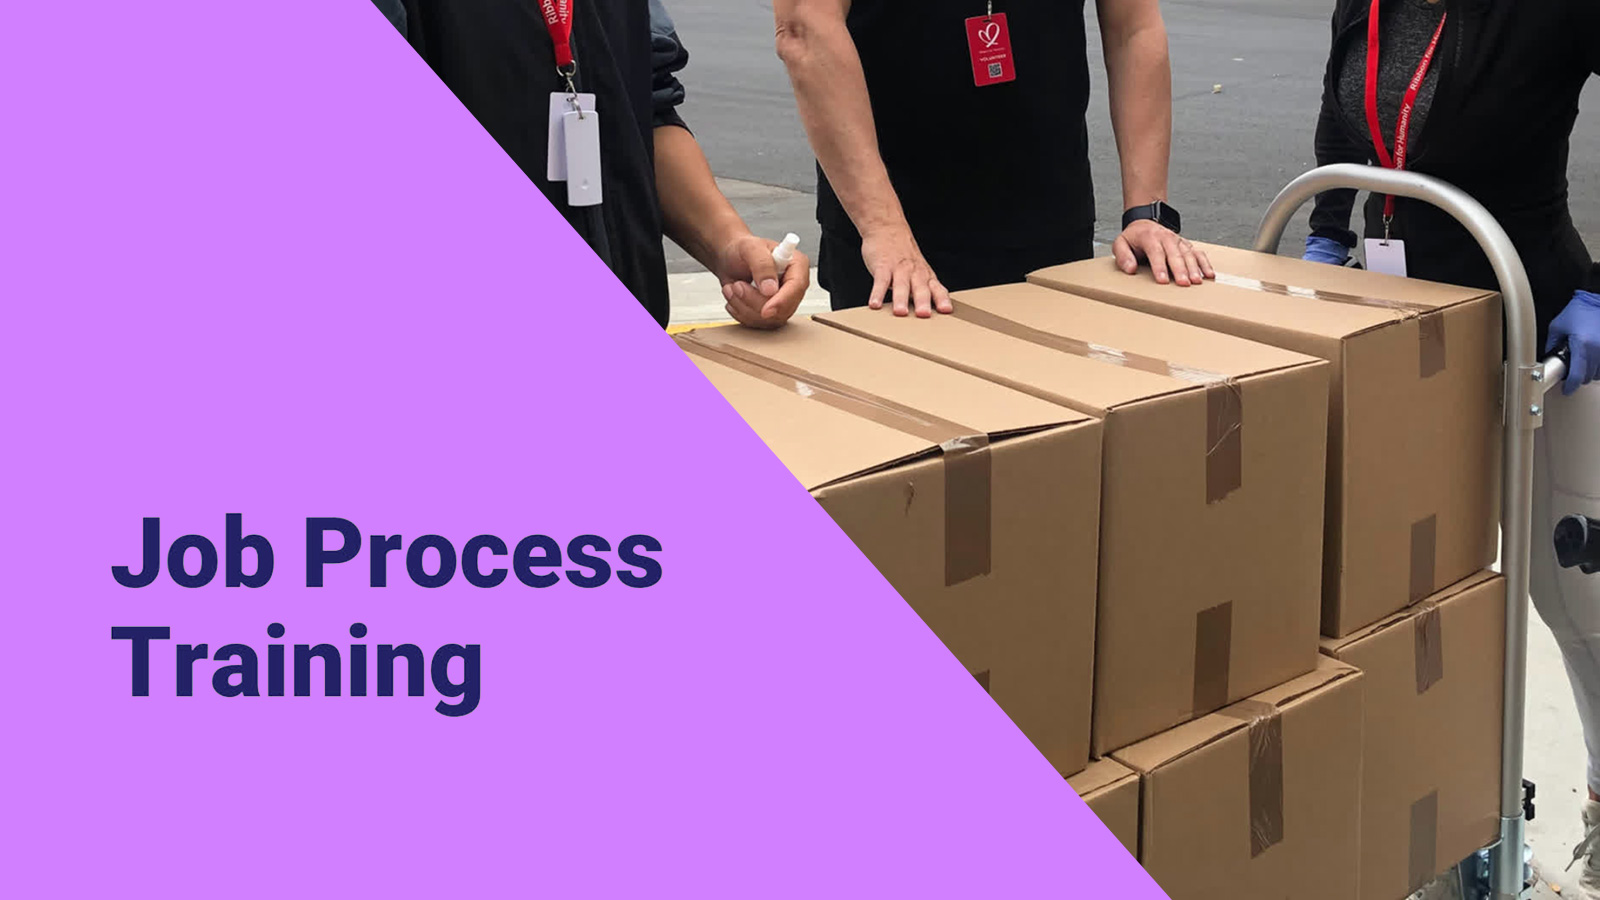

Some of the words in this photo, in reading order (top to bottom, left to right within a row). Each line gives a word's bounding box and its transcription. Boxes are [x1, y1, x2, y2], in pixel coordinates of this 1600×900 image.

[1409, 60, 1428, 91] Ribbon
[1424, 46, 1434, 59] for
[1396, 103, 1411, 145] Humanity
[1395, 144, 1404, 157] for
